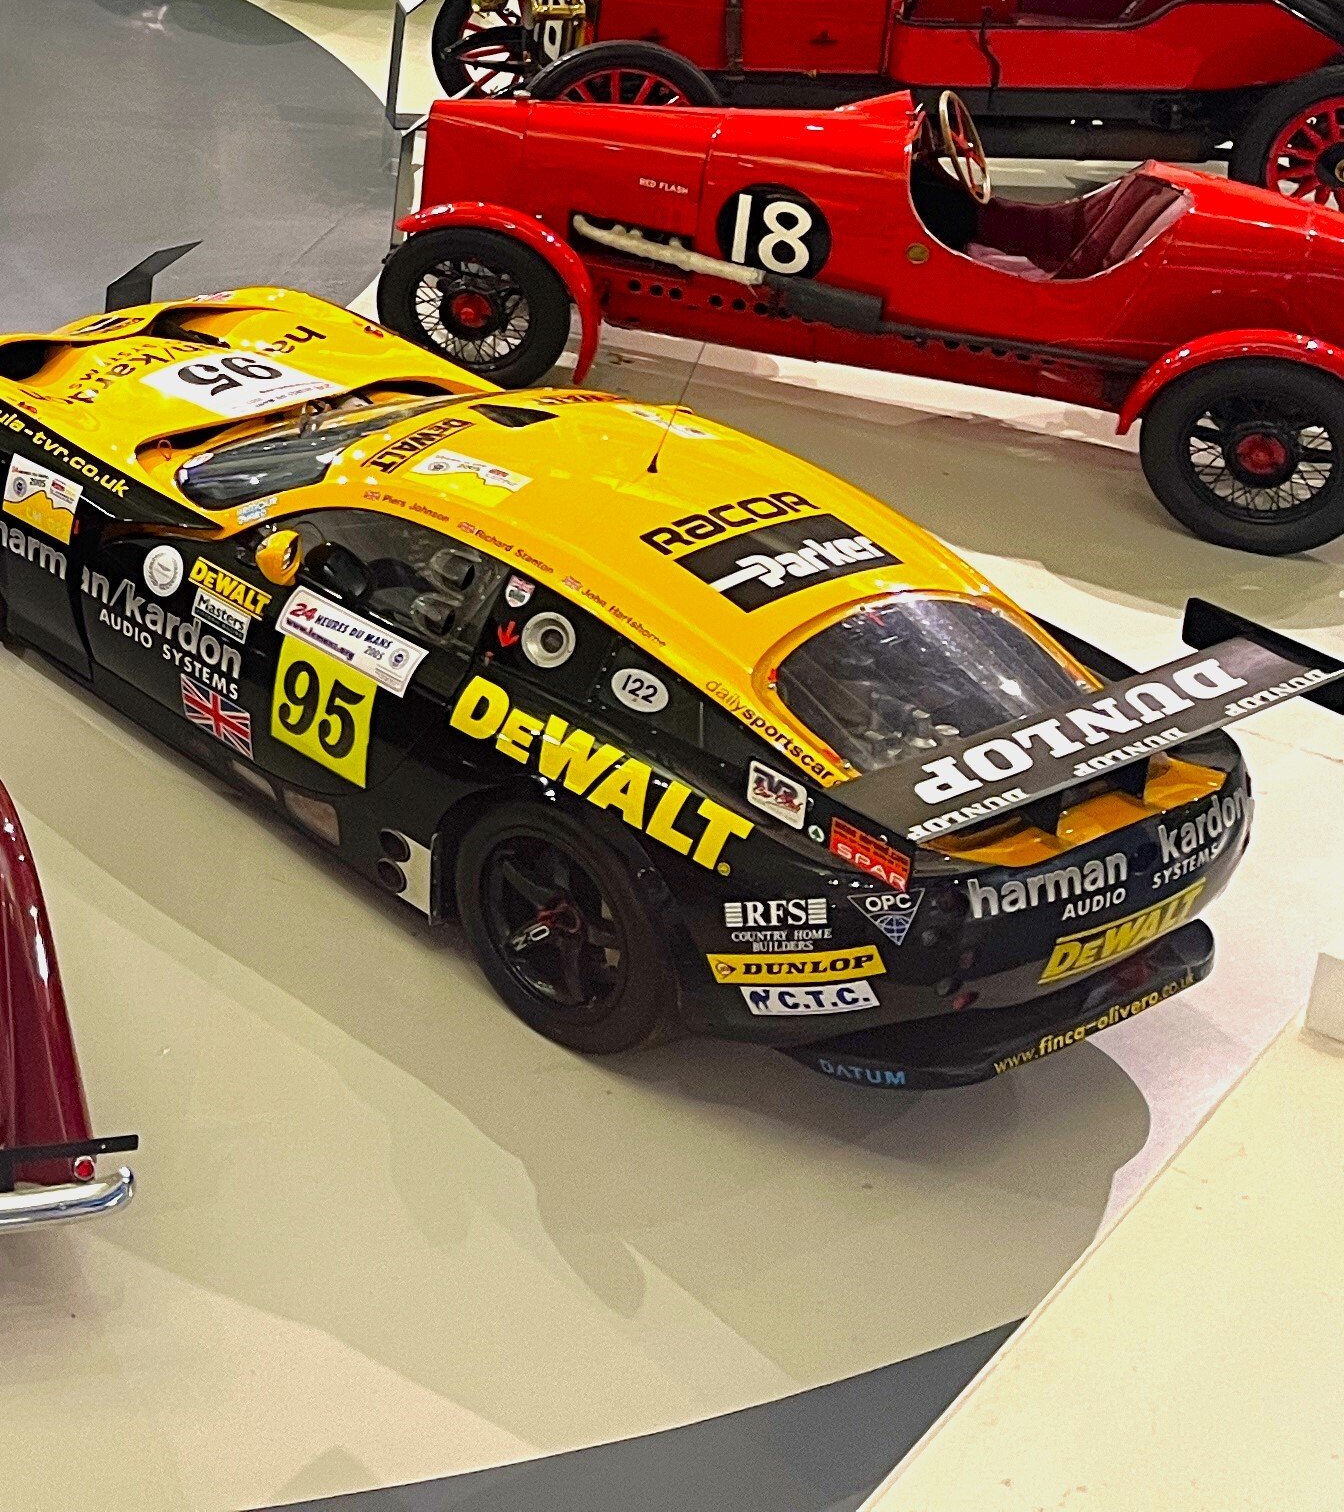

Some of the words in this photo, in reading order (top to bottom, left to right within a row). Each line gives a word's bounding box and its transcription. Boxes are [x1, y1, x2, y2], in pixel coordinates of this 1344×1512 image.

[639, 178, 657, 188] RED
[659, 181, 689, 195] FLASH
[731, 193, 813, 274] 18
[177, 356, 283, 397] 95
[381, 494, 406, 509] Piers
[408, 502, 450, 522] Johnson
[474, 528, 513, 552] Richard
[514, 548, 555, 575] Stanton
[709, 535, 877, 589] Parker
[197, 593, 245, 632] Masters
[580, 588, 608, 608] John
[289, 602, 318, 622] 24
[314, 614, 350, 634] HEURES
[350, 626, 363, 640] DU
[363, 633, 393, 650] MANS
[99, 608, 153, 649] AUDIO
[162, 644, 239, 700] SYSTEMS
[363, 645, 385, 661] 2005
[278, 660, 366, 759] 95
[620, 673, 659, 704] 122
[1224, 668, 1334, 718] DUNLOP
[914, 658, 1249, 805] DUNLOP
[1073, 727, 1189, 777] DUNLOP
[906, 787, 1031, 842] DUNLOP
[837, 841, 907, 892] SPAR
[967, 852, 1128, 919] harman
[1157, 787, 1253, 865] kardon
[865, 893, 912, 912] OPC
[1062, 888, 1127, 921] AUDIO
[1152, 841, 1221, 889] SYSTEMS
[730, 930, 788, 943] COUNTRY
[793, 927, 833, 940] HOME
[744, 899, 809, 927] RFS
[742, 954, 874, 976] DUNLOP
[752, 940, 814, 952] BUILDERS
[777, 987, 871, 1010] C.T.C.
[993, 973, 1196, 1075] www.finca-olivero.co.uk
[818, 1058, 907, 1085] DATUM
